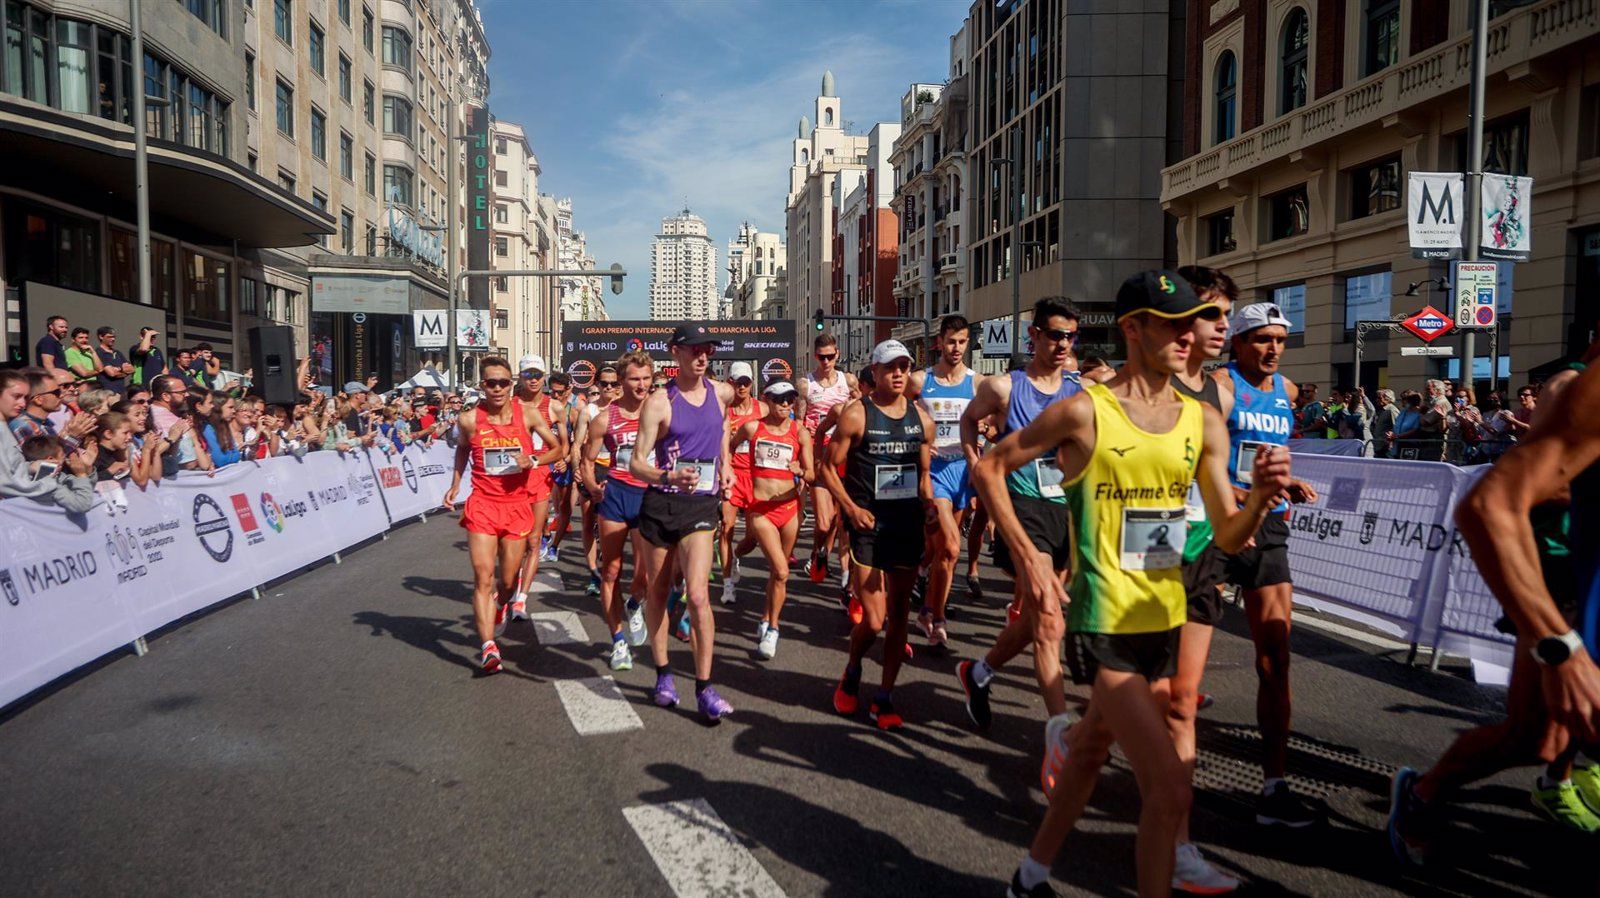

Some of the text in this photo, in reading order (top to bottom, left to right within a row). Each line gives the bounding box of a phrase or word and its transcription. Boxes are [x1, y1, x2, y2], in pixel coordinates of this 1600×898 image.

[474, 133, 487, 231] HOTEL
[1419, 318, 1442, 328] Metro
[579, 342, 618, 350] MADRID
[939, 426, 951, 437] 37
[1238, 411, 1290, 435] INDIA
[481, 437, 520, 448] CHINA
[497, 454, 510, 465] 13
[767, 448, 780, 459] 59
[319, 485, 347, 506] MADRID
[1095, 481, 1164, 501] Fiamme
[280, 499, 307, 518] LaLiga
[1148, 524, 1169, 545] 2
[1290, 510, 1344, 540] LaLiga
[23, 550, 97, 594] MADRID
